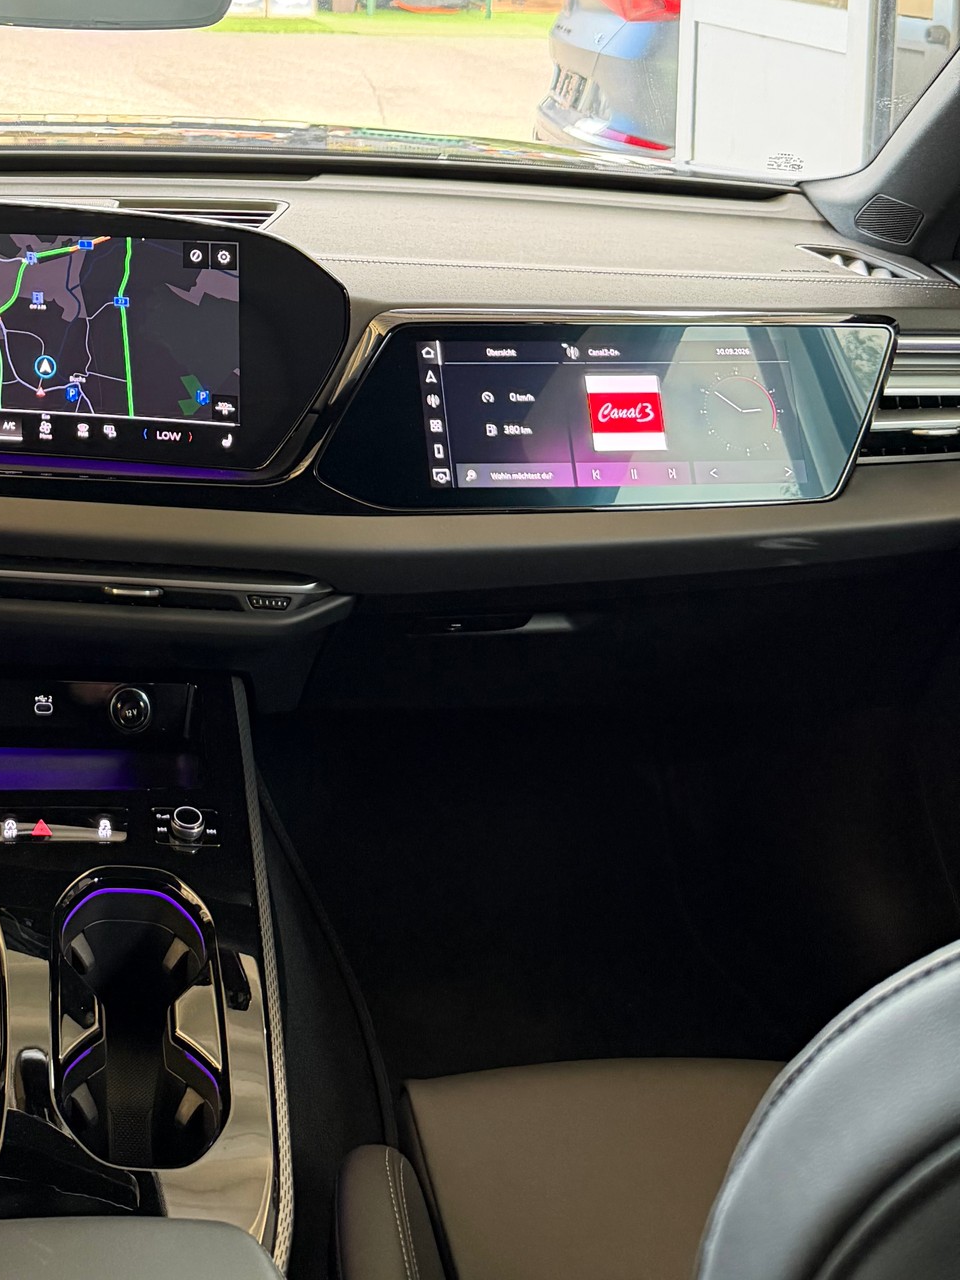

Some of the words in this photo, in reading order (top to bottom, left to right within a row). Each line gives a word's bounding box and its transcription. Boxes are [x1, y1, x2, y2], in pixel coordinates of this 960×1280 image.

[486, 348, 517, 357] Übersicht
[516, 393, 536, 402] km/h
[598, 402, 654, 423] Canal3
[2, 421, 16, 430] A/C
[504, 425, 521, 435] 380
[521, 425, 533, 435] km
[156, 430, 182, 441] LOW
[490, 472, 512, 480] Wohin
[512, 472, 541, 480] möchtest
[541, 472, 553, 480] du?
[4, 829, 18, 838] OFF
[98, 829, 112, 838] OFF
